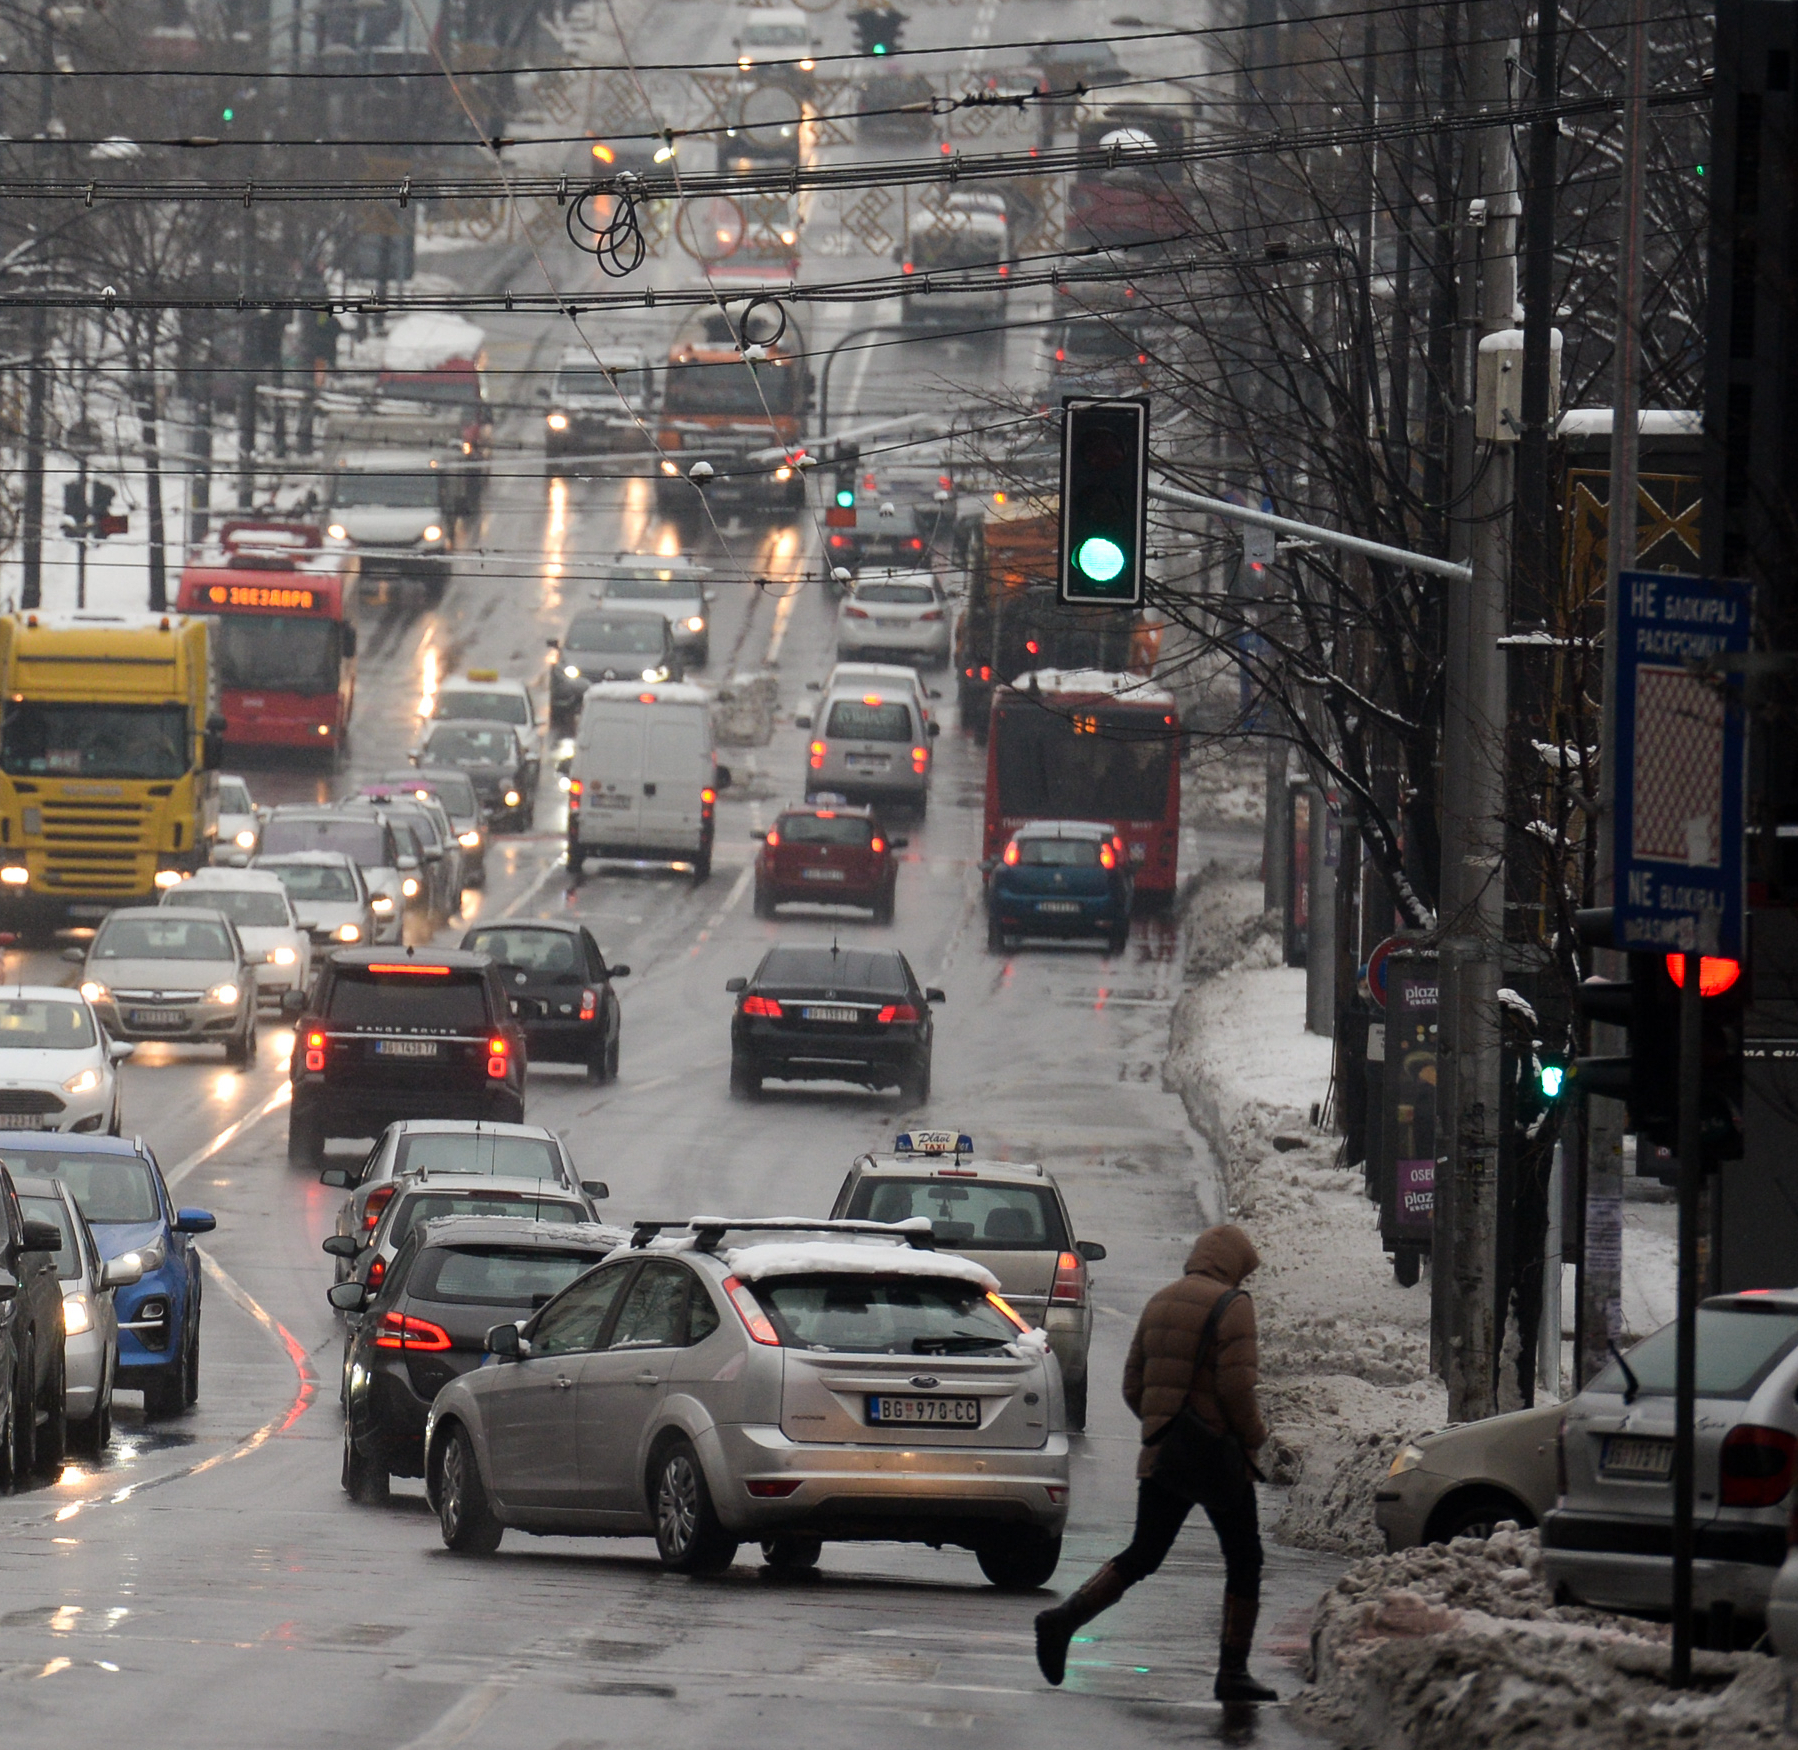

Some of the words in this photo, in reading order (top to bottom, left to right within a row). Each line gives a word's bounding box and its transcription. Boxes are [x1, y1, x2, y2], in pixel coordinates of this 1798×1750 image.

[1630, 581, 1658, 618] НЕ
[1628, 870, 1654, 907] NE
[356, 1025, 402, 1034] RANGE
[410, 1027, 457, 1035] ROVER
[919, 1132, 951, 1147] Plavi
[882, 1401, 902, 1418] BG
